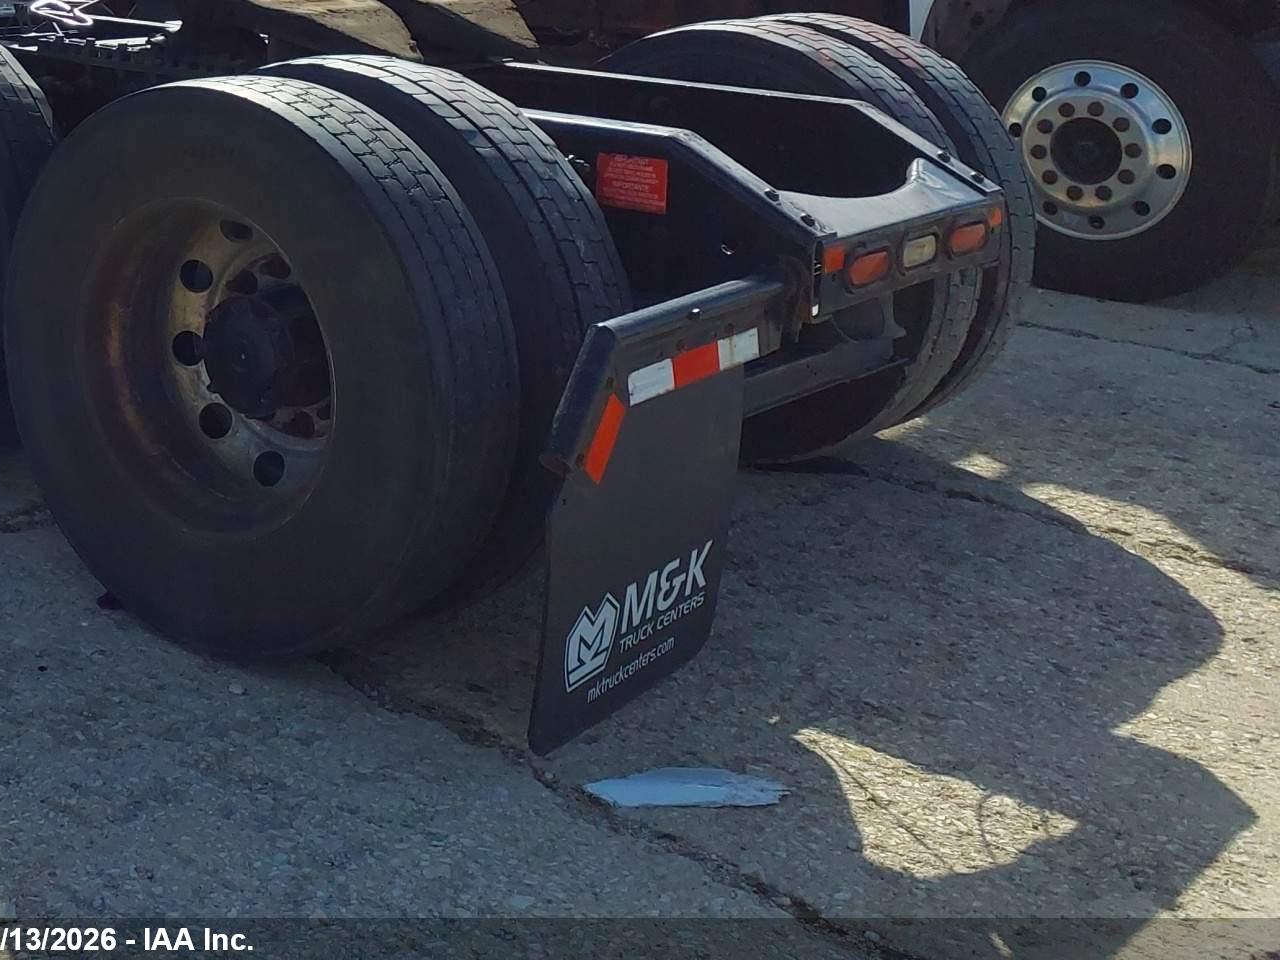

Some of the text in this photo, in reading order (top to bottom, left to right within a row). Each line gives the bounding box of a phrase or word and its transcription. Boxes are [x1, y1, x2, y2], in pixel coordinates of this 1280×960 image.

[620, 592, 705, 653] TRUCK CENTERS
[621, 540, 713, 634] M&K
